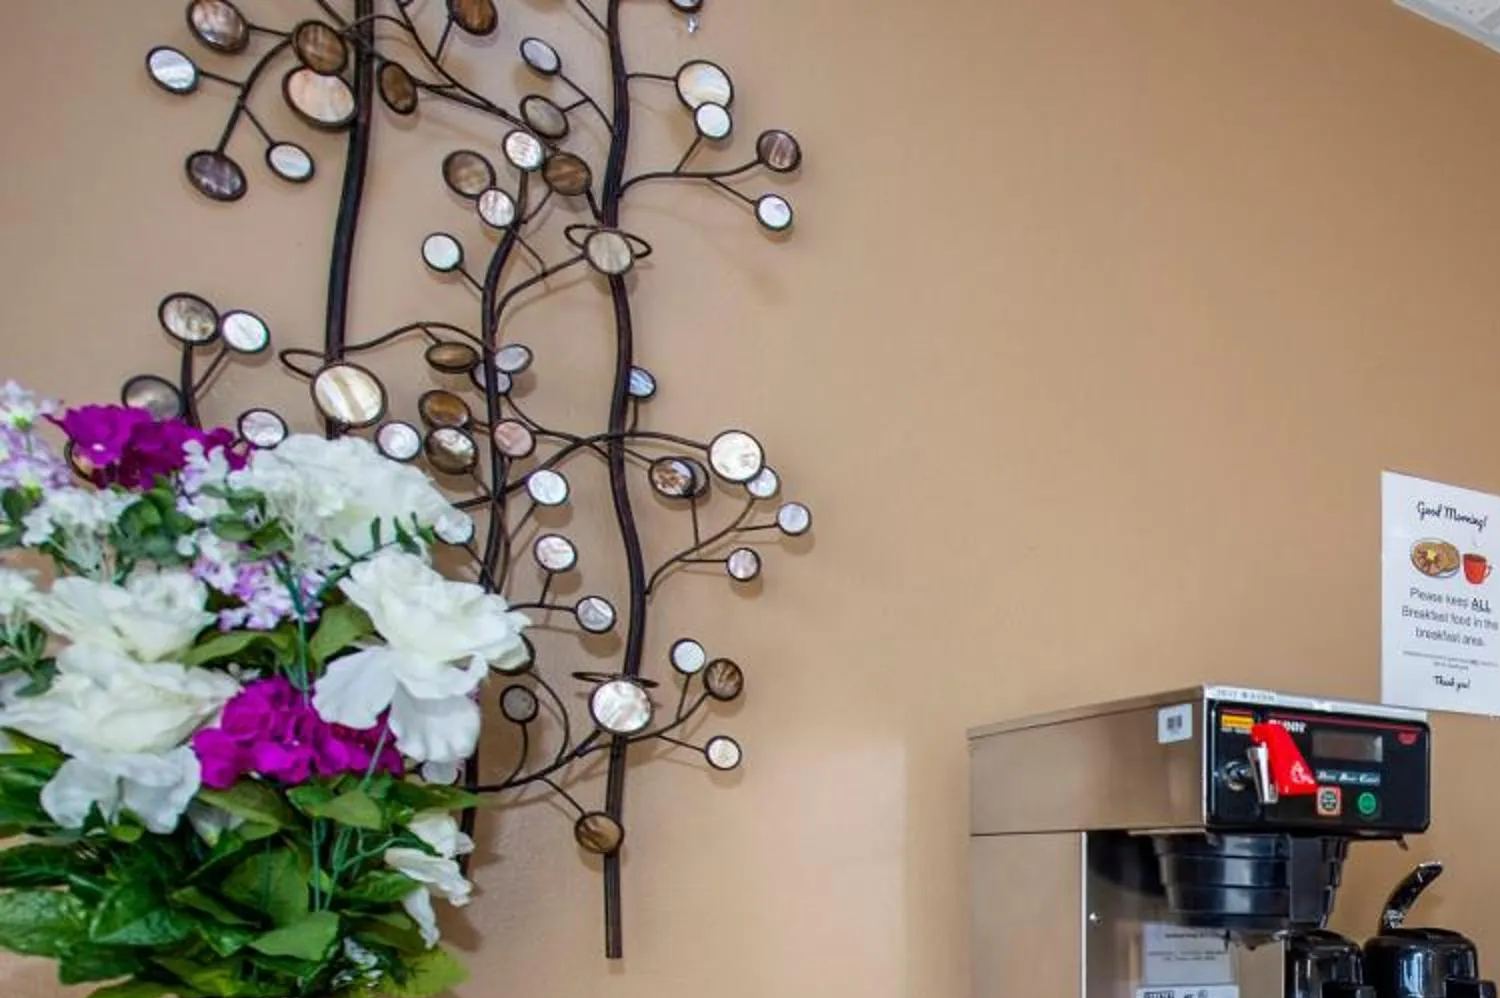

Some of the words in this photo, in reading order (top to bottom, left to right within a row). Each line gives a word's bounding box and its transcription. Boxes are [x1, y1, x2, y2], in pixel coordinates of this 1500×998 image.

[1416, 501, 1443, 521] Good
[1444, 505, 1488, 532] Morning!
[1409, 587, 1443, 604] Please
[1446, 593, 1469, 609] keep
[1471, 597, 1491, 613] ALL
[1401, 605, 1449, 622] Breakfast
[1451, 612, 1471, 627] food
[1474, 615, 1483, 629] in
[1484, 617, 1499, 630] the
[1415, 626, 1460, 643] breakfast
[1433, 675, 1455, 687] Thank
